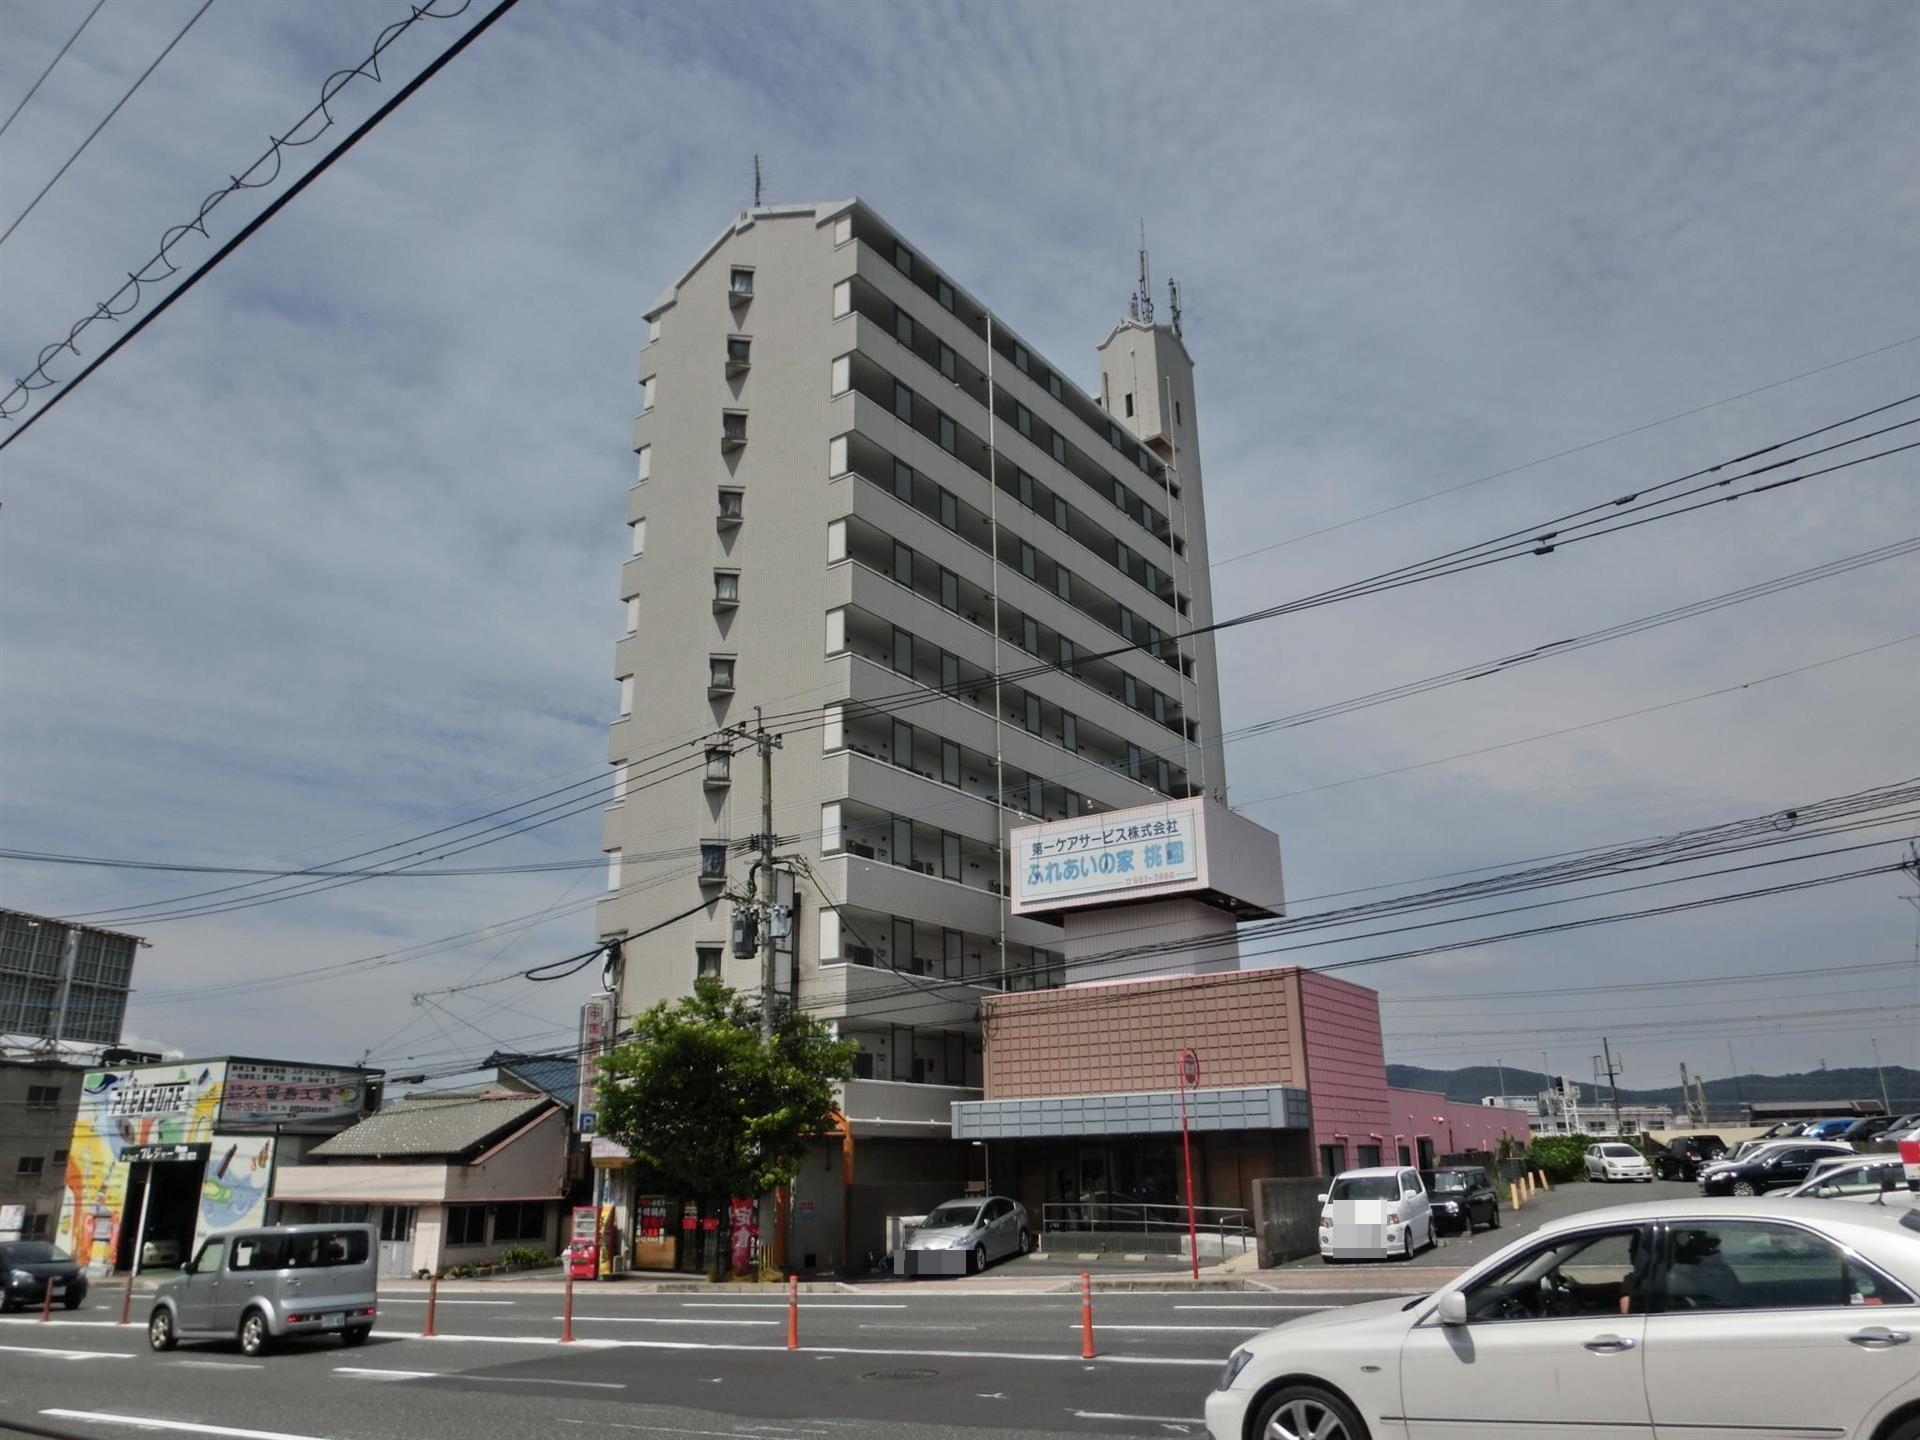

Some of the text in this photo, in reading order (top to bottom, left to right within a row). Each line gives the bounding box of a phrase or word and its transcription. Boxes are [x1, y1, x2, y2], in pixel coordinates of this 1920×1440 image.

[1032, 819, 1178, 856] 第一ケアサービス株式会社
[1027, 849, 1134, 886] ふれあいの家
[112, 1086, 185, 1115] PLEASURE
